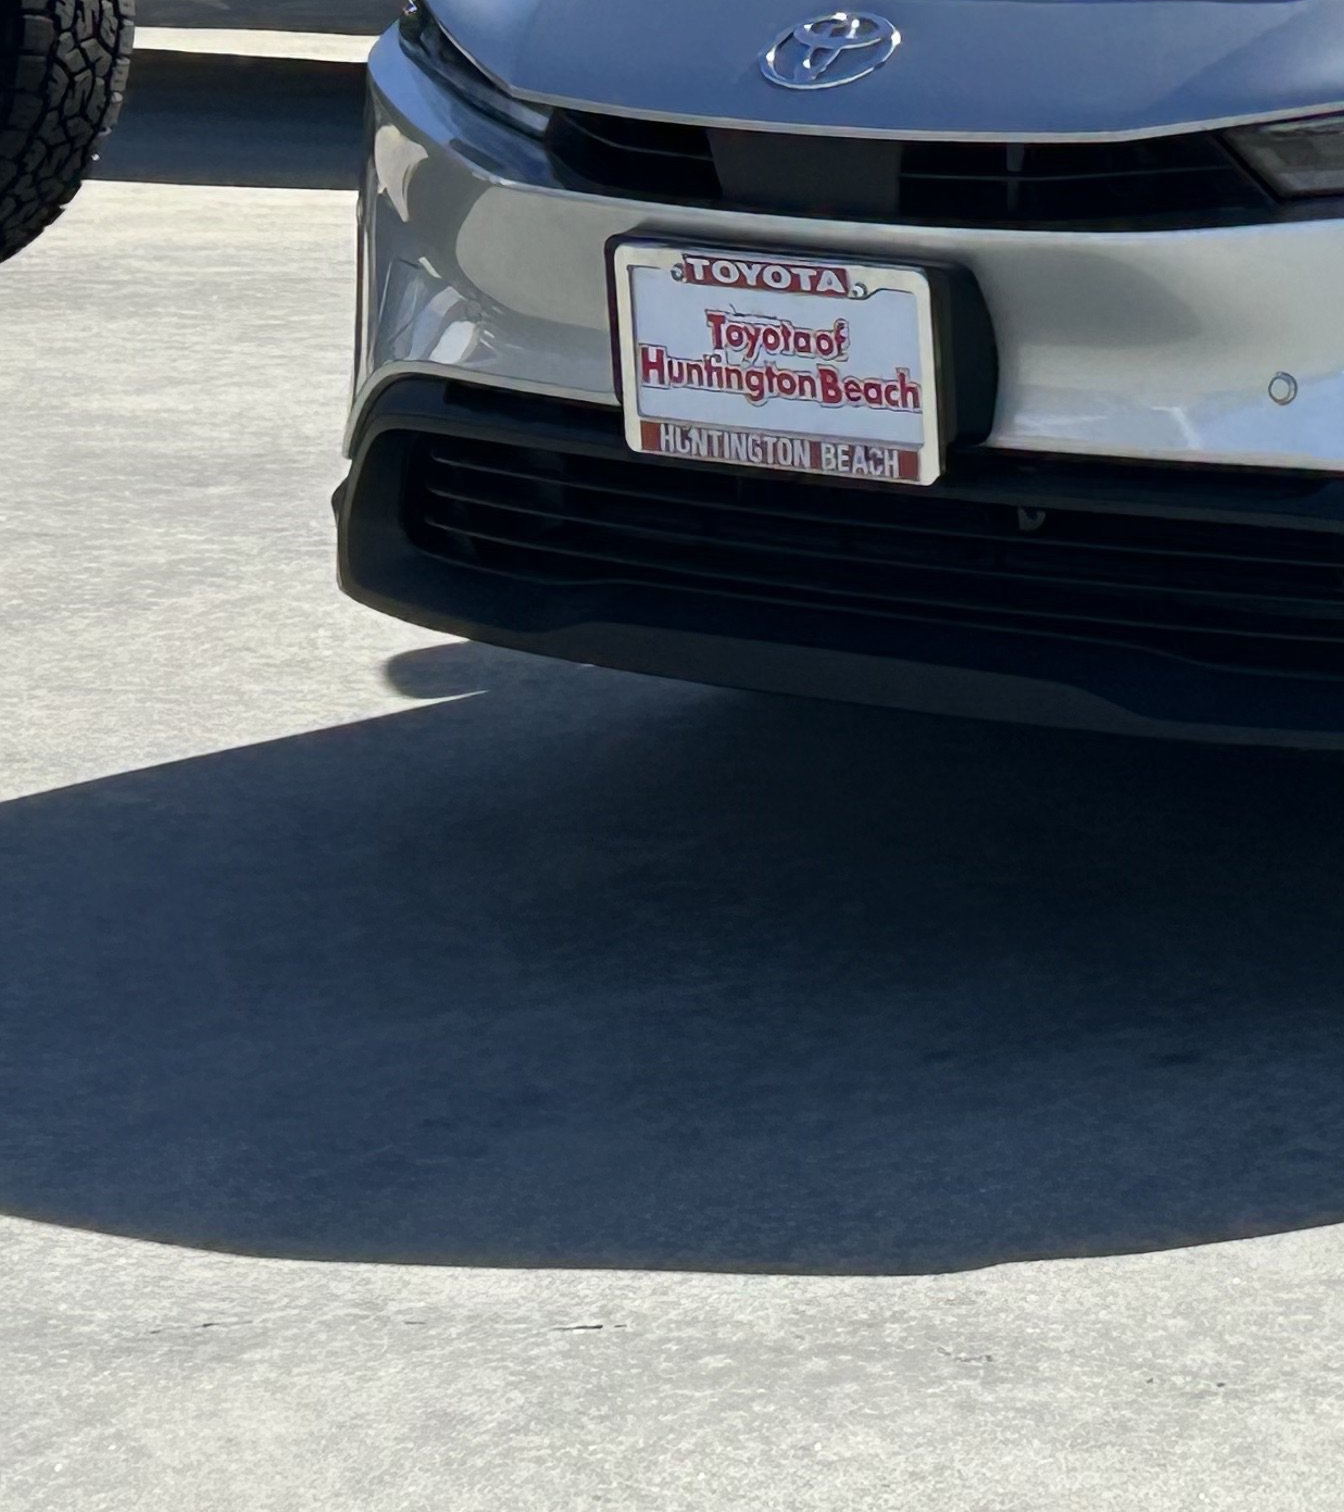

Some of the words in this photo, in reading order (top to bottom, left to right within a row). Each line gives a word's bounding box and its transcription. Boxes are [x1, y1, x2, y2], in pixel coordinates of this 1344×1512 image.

[685, 257, 846, 294] TOYOTA
[706, 312, 812, 360] Toyota
[815, 319, 849, 358] of
[641, 346, 817, 402] Huntington
[818, 365, 921, 411] Beach
[659, 423, 812, 469] HUNTINGTON
[820, 442, 899, 479] BEACH
